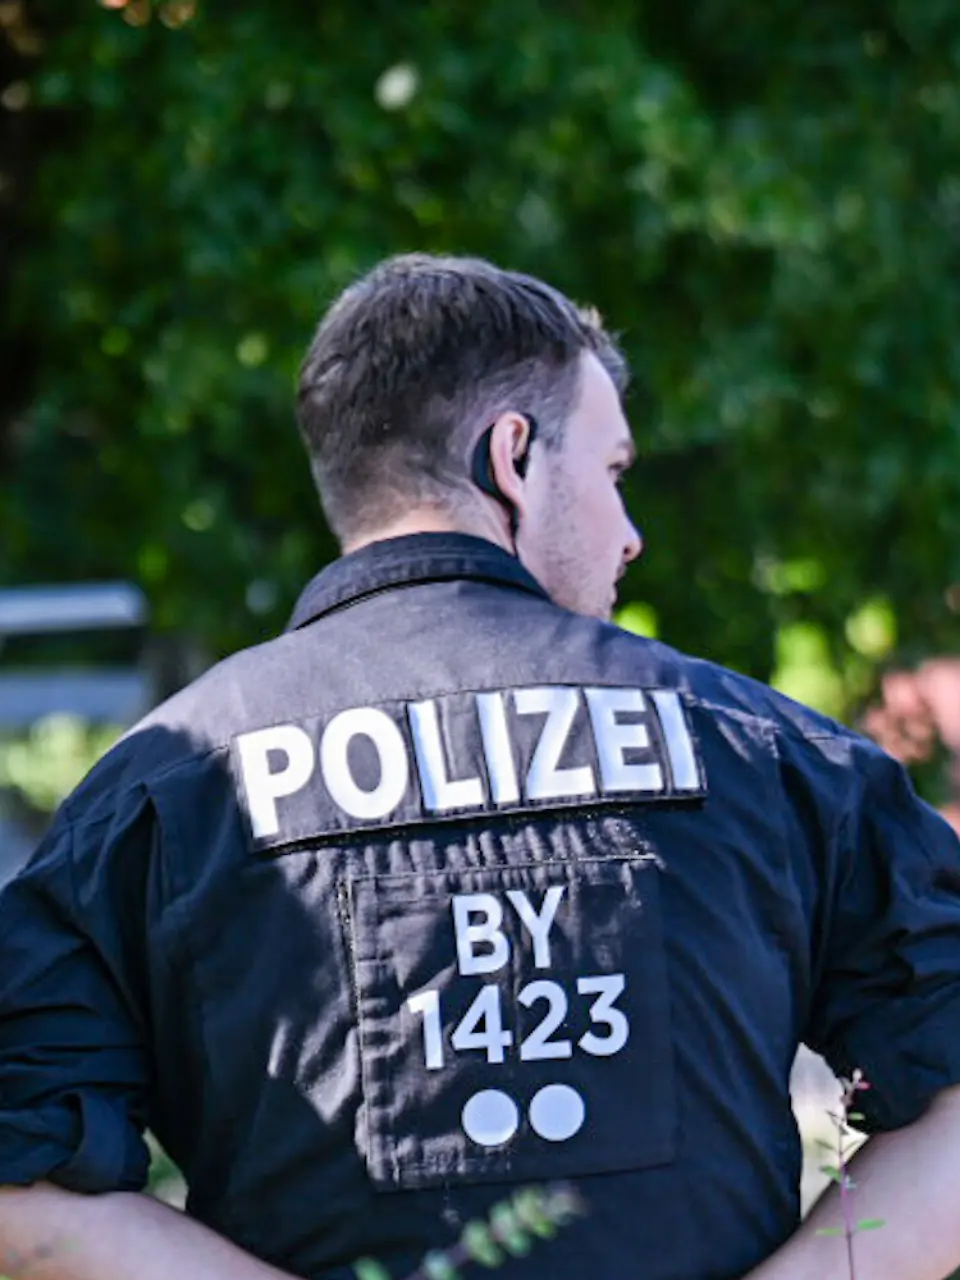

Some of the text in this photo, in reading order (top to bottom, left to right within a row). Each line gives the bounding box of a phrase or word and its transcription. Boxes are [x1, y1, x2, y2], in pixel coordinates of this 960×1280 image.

[234, 687, 699, 837] POLIZEI
[451, 886, 565, 976] BY
[407, 974, 630, 1070] 1423
